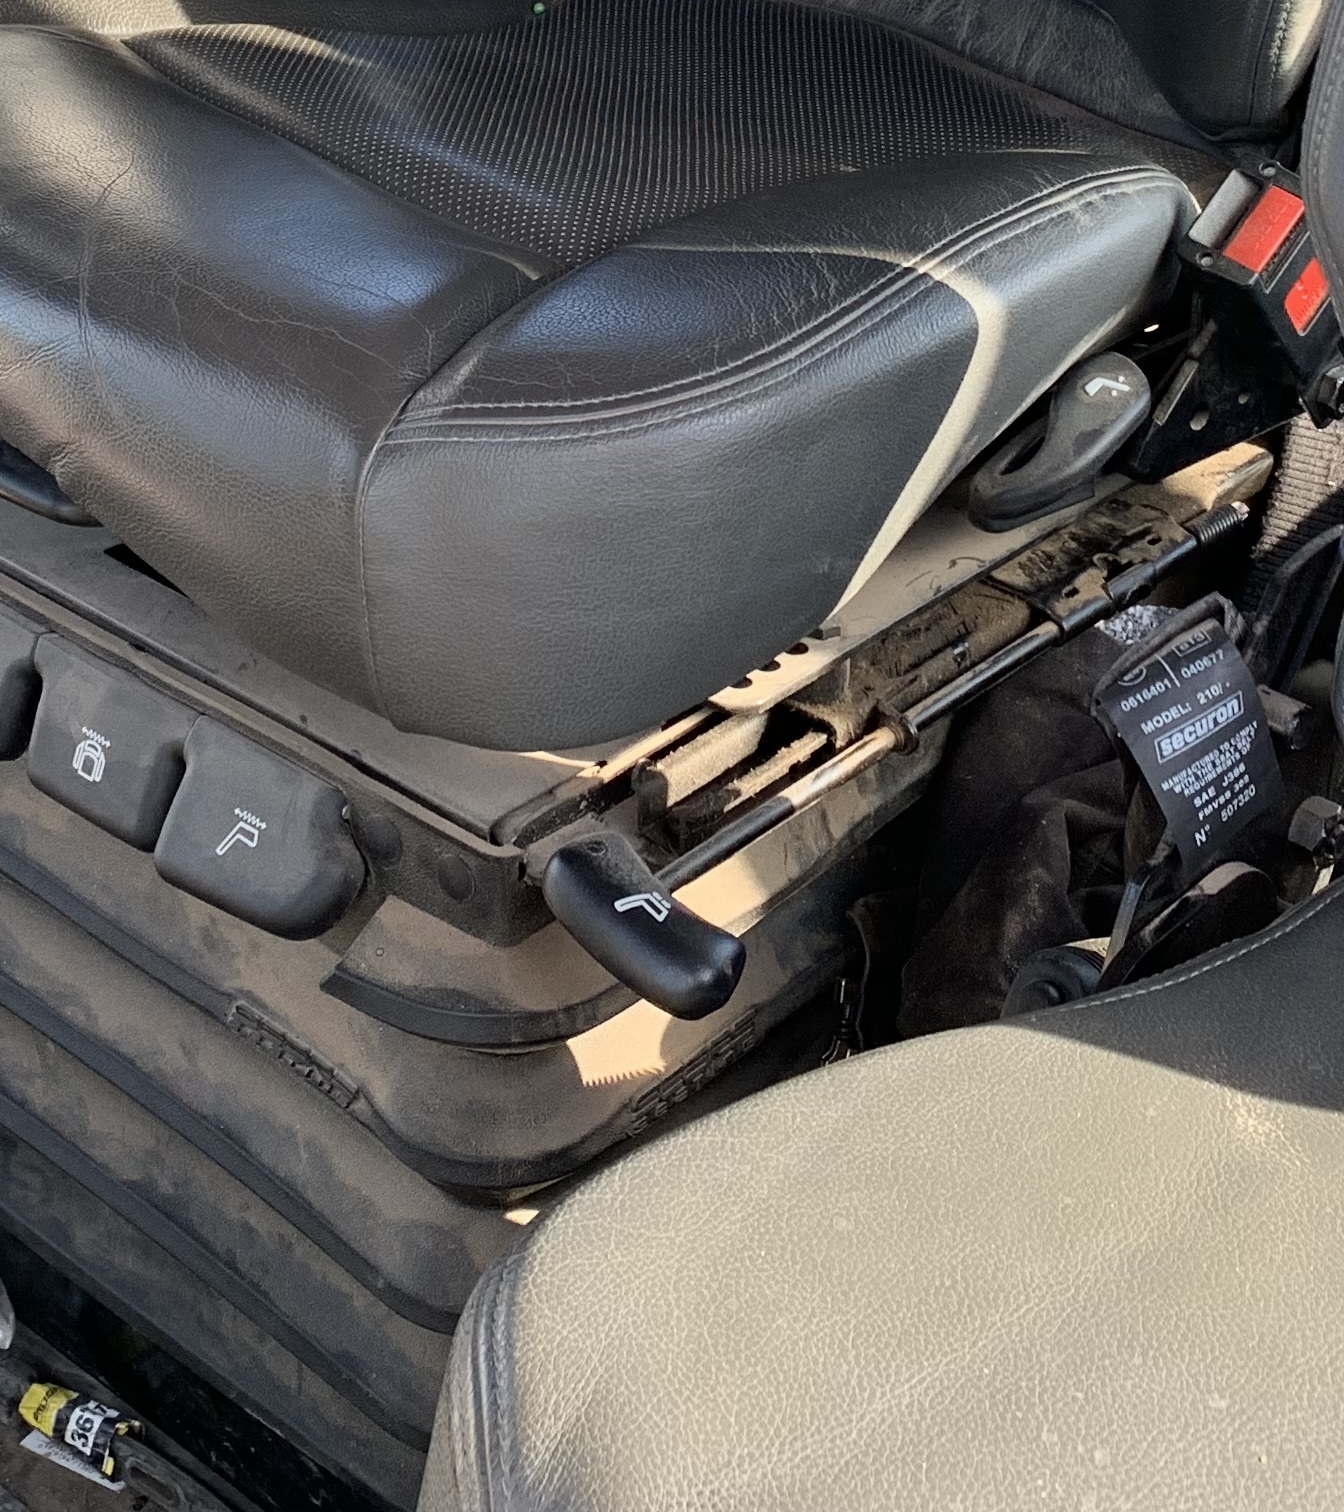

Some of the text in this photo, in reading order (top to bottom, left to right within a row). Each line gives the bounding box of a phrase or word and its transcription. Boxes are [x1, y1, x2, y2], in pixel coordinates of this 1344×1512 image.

[1140, 702, 1192, 735] MODEL:
[1160, 699, 1239, 757] securon
[1161, 720, 1258, 792] MANUFACTURED TO COMPLY
[1173, 732, 1255, 794] WITH THE SEAT BELT
[1183, 741, 1251, 798] REQUIREMENTS OF
[1193, 785, 1216, 808] SAE
[1198, 790, 1232, 821] FMVSS
[1220, 783, 1256, 822] 507320
